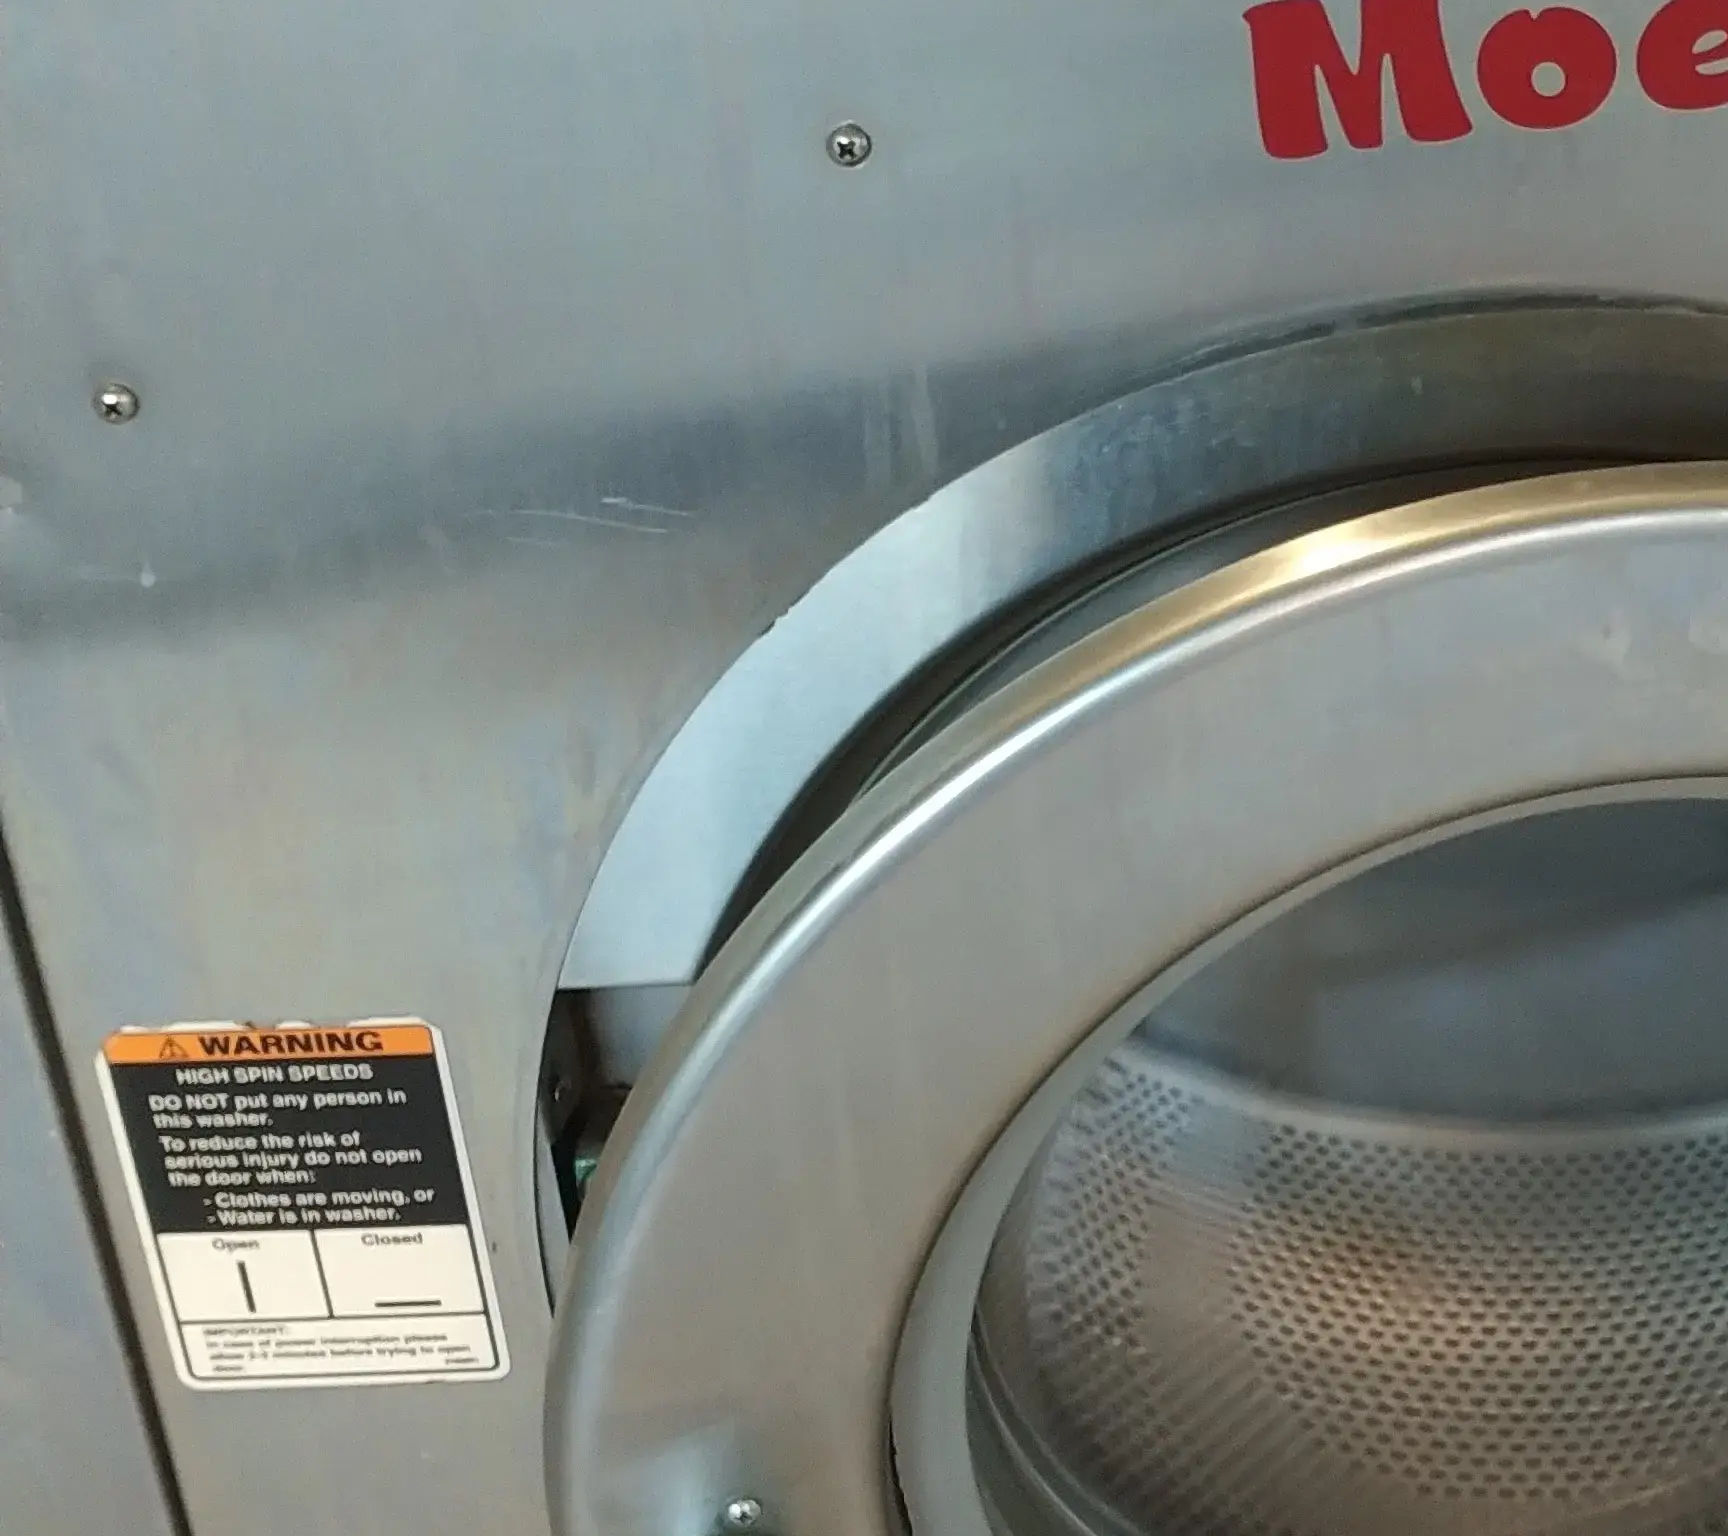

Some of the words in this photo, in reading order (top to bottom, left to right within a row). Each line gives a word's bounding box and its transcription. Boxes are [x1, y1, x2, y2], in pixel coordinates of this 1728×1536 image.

[198, 1030, 384, 1056] WARNING
[175, 1067, 230, 1086] HIGH
[233, 1065, 284, 1084] SPIN
[288, 1063, 374, 1082] SPEEDS
[148, 1094, 182, 1112] DO
[185, 1093, 229, 1111] NOT
[234, 1092, 269, 1113] put
[272, 1092, 308, 1111] any
[314, 1089, 382, 1110] person
[387, 1088, 407, 1104] in
[153, 1113, 193, 1129] this
[195, 1112, 274, 1128] washer.
[158, 1135, 186, 1153] To
[189, 1133, 258, 1151] reduce
[261, 1133, 294, 1149] the
[299, 1131, 336, 1148] risk
[340, 1130, 361, 1147] of
[164, 1153, 238, 1170] serious
[243, 1152, 299, 1170] injury
[304, 1149, 330, 1166] do
[335, 1149, 368, 1164] not
[372, 1148, 423, 1167] open
[167, 1171, 201, 1187] the
[205, 1170, 251, 1186] door
[295, 1192, 327, 1206] are
[413, 1188, 435, 1204] or
[278, 1209, 298, 1224] is
[301, 1207, 321, 1223] in
[212, 1237, 260, 1253] Open
[361, 1231, 423, 1246] Closed
